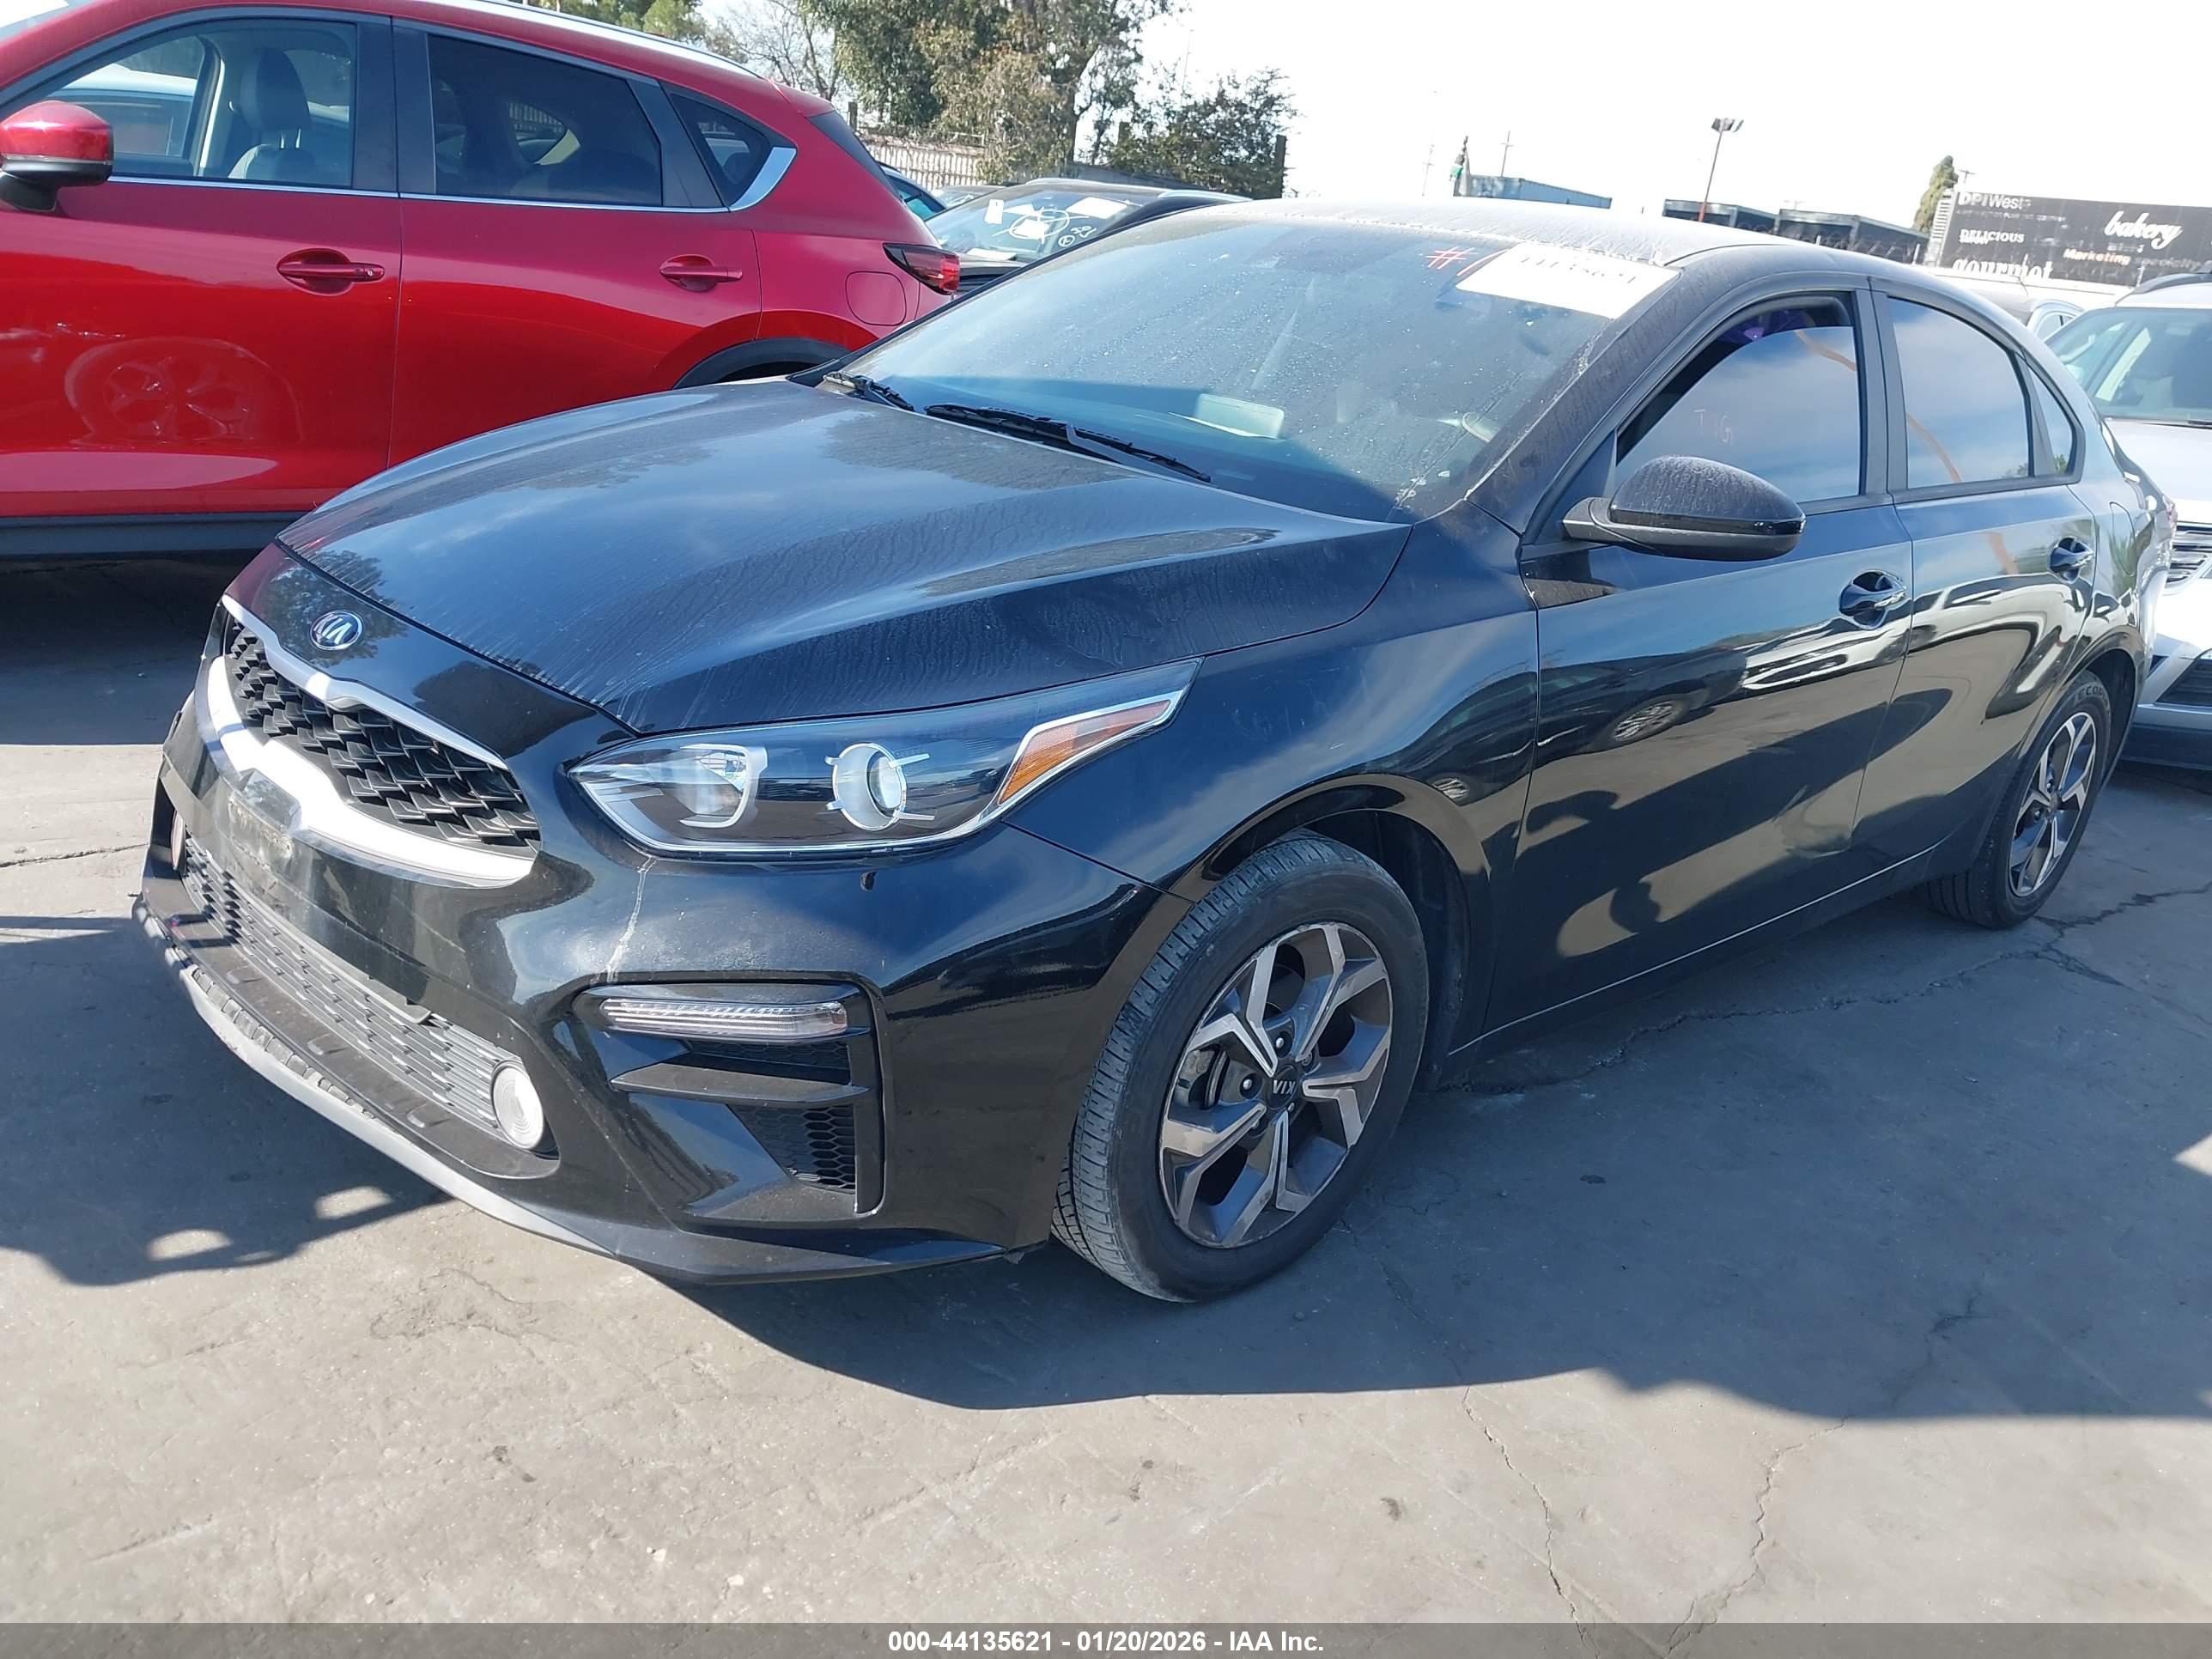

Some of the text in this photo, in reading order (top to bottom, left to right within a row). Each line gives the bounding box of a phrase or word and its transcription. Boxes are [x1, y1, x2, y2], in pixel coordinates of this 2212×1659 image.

[2104, 211, 2183, 249] bakery
[2063, 248, 2131, 266] Marketing
[313, 614, 352, 645] KIA
[1273, 1079, 1297, 1094] KIA
